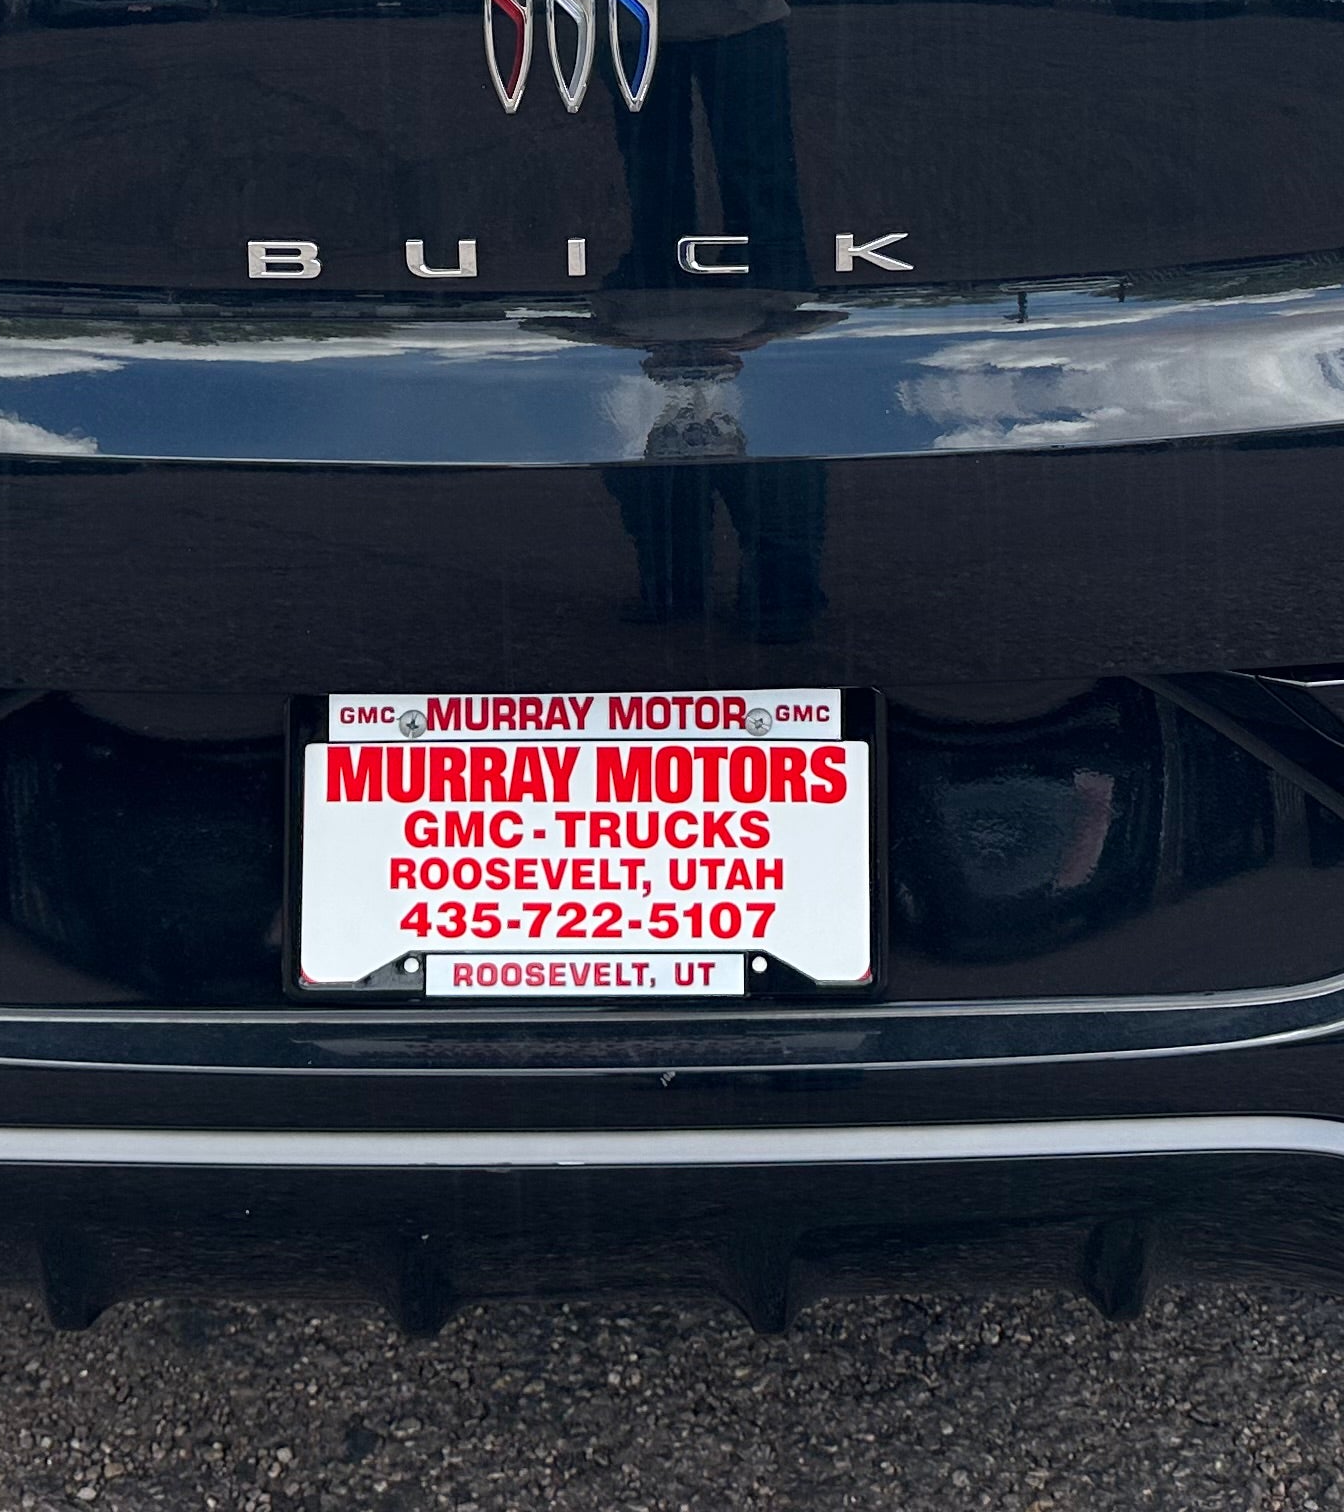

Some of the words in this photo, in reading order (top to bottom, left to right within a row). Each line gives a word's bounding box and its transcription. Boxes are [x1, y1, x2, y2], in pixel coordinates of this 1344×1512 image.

[247, 232, 914, 279] BUICK
[339, 706, 396, 725] GMC
[426, 696, 594, 731] MURRAY
[608, 695, 747, 730] MOTOR
[775, 704, 830, 723] GMC
[326, 746, 581, 803] MURRAY
[595, 744, 848, 804] MOTORS
[403, 810, 527, 849] GMC
[555, 810, 771, 849] TRUCKS
[389, 857, 652, 897] ROOSEVELT,
[669, 857, 785, 890] UTAH
[399, 901, 777, 939] 435-722-5107
[453, 961, 656, 989] ROOSEVELT,
[673, 961, 716, 987] UT
